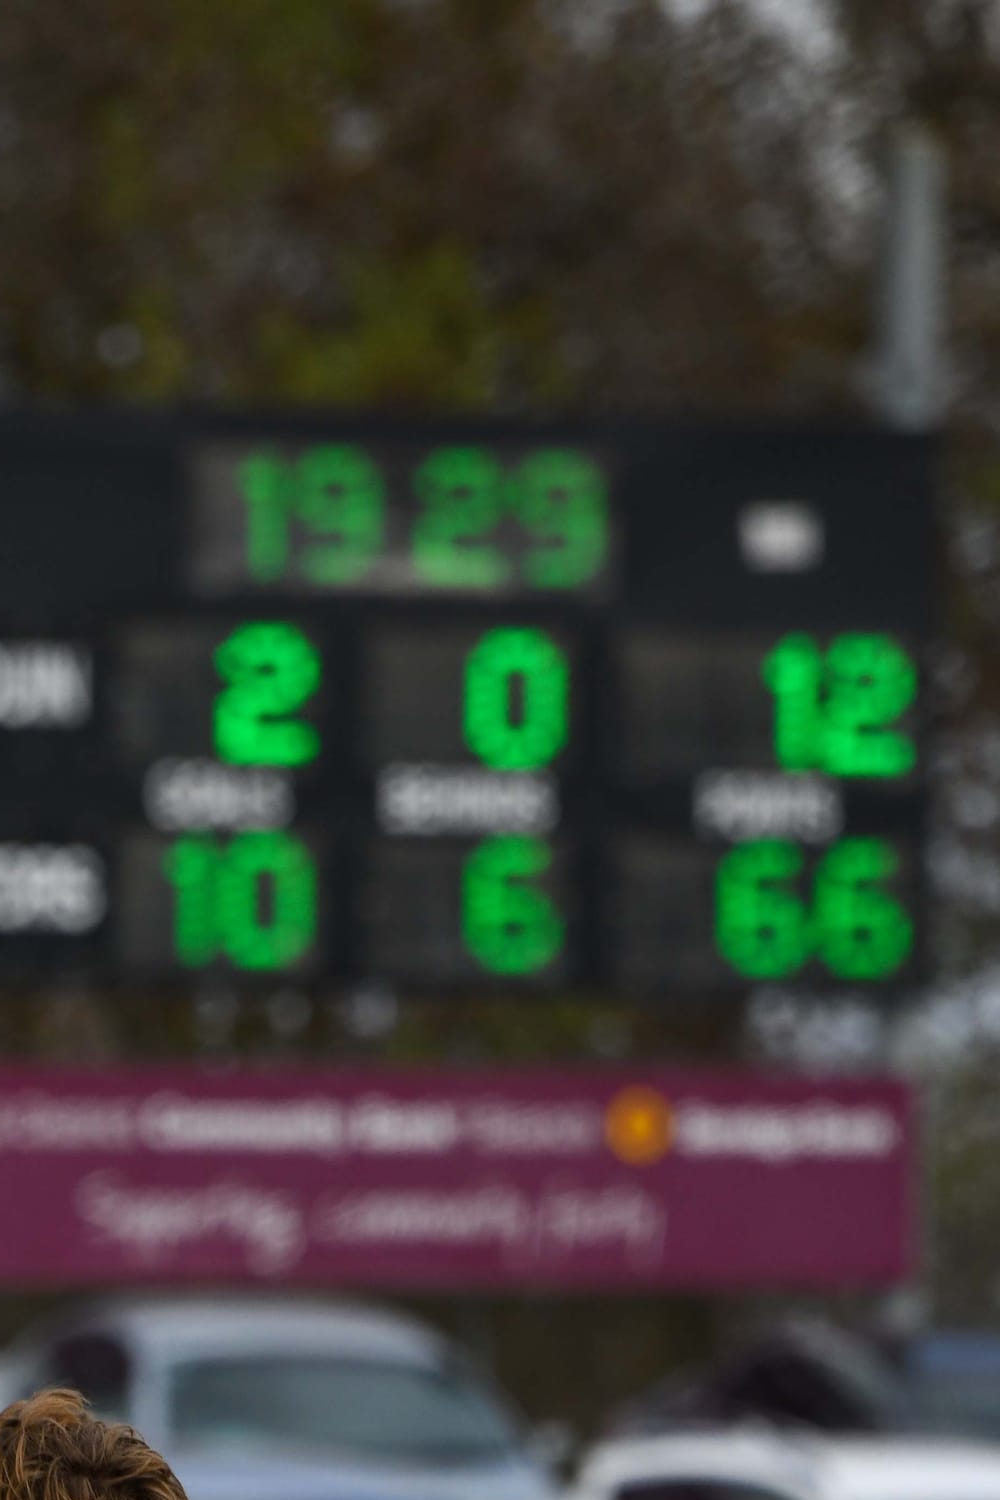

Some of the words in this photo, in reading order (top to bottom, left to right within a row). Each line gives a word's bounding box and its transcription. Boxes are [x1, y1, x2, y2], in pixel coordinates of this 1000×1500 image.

[213, 622, 320, 766] 2
[464, 627, 567, 770] 0
[763, 633, 915, 776] 12
[164, 831, 317, 968] 10
[462, 836, 563, 974] 6
[715, 838, 911, 978] 66
